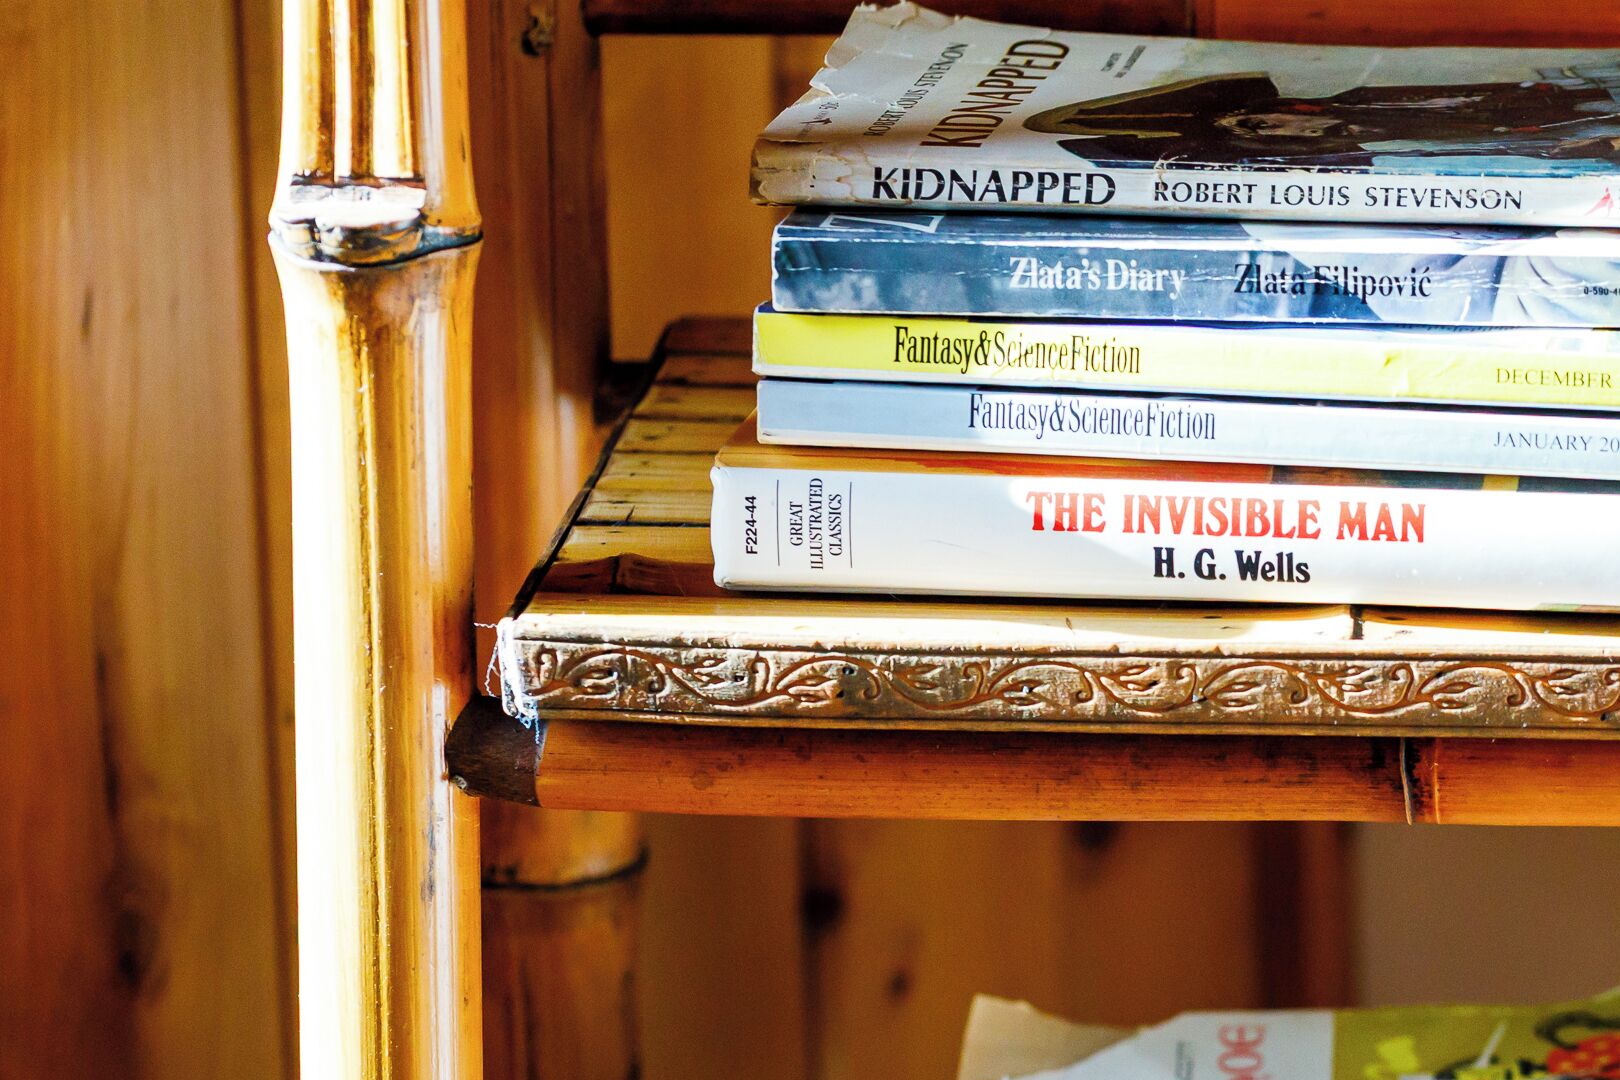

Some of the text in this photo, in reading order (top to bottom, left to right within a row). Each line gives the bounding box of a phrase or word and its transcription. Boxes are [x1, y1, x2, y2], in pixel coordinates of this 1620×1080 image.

[864, 109, 907, 137] ROBERT
[914, 42, 969, 88] STEVENSON
[919, 38, 1071, 148] KIDNAPPED
[871, 165, 1523, 211] KIDNAPPED ROBERT LOUIS STEVENSON
[1009, 256, 1433, 305] Zlata's Diary Zlata Filipović
[1494, 367, 1615, 391] DECEMBER
[1494, 430, 1593, 452] JANUARY
[744, 494, 758, 556] F224-44
[789, 500, 804, 547] GREAT
[809, 477, 824, 570] ILLUSTRATED
[827, 492, 843, 557] CLASSICS
[1026, 490, 1427, 544] THE INVISIBLE MAN
[1152, 546, 1312, 584] H. G. Wells
